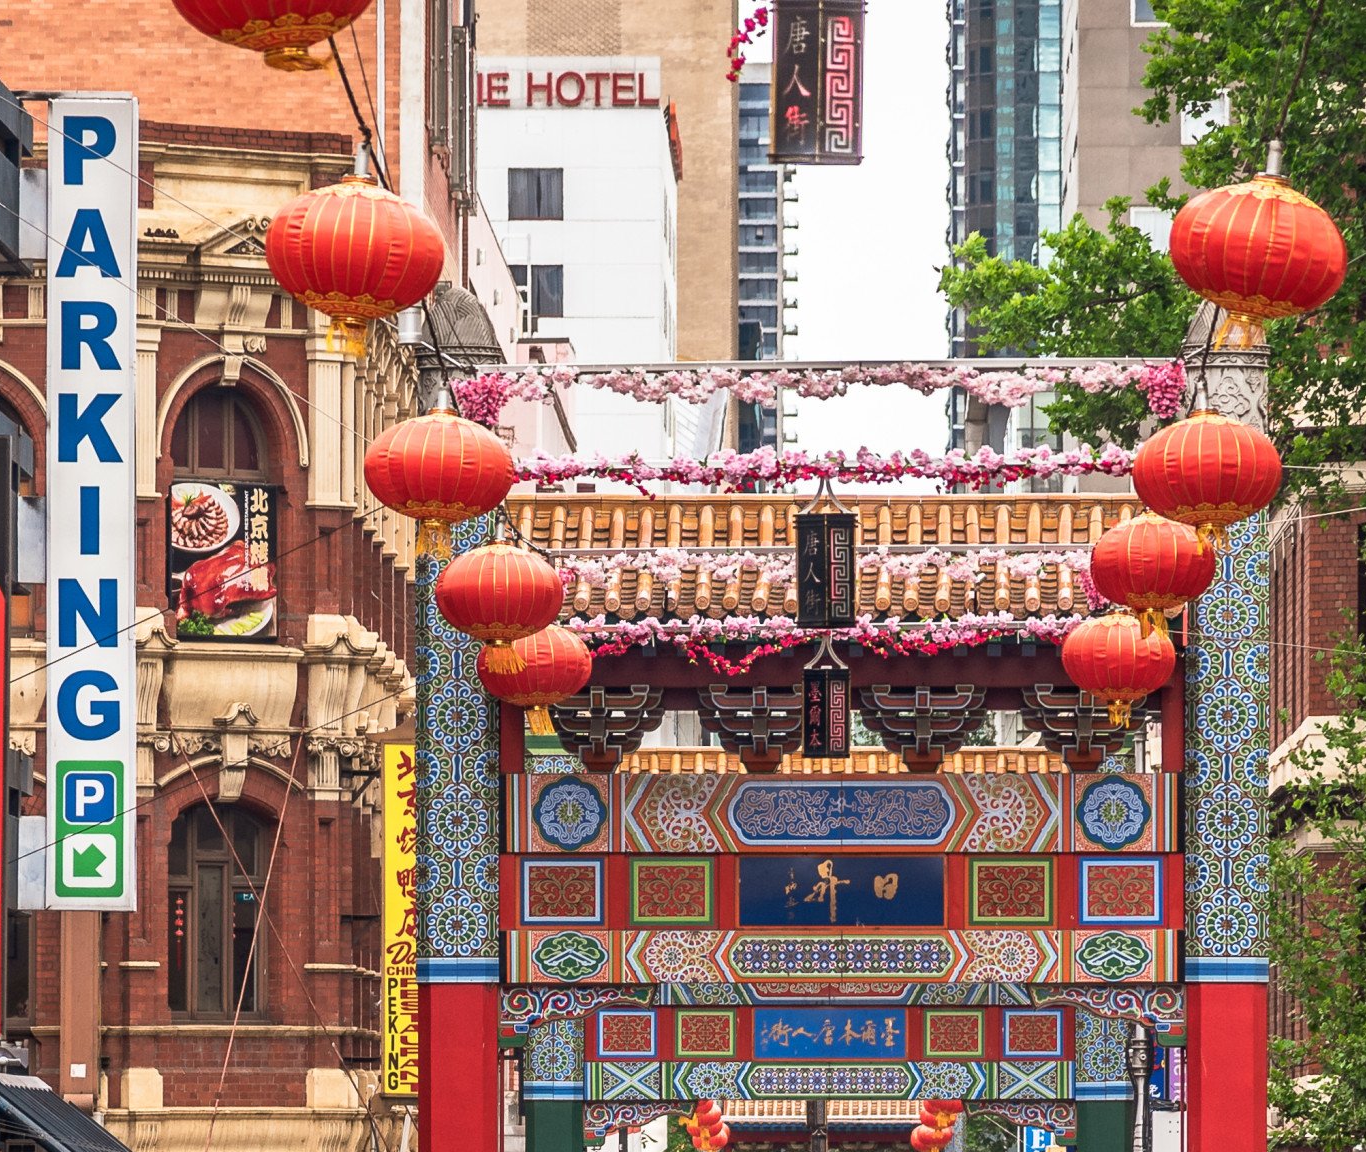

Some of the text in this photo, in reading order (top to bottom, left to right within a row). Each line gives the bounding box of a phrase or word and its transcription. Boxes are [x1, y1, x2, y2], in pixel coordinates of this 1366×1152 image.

[526, 71, 660, 107] HOTEL
[55, 115, 123, 741] PARKING
[386, 941, 417, 966] Da
[387, 966, 417, 976] CHIN
[388, 977, 399, 1091] PEKING
